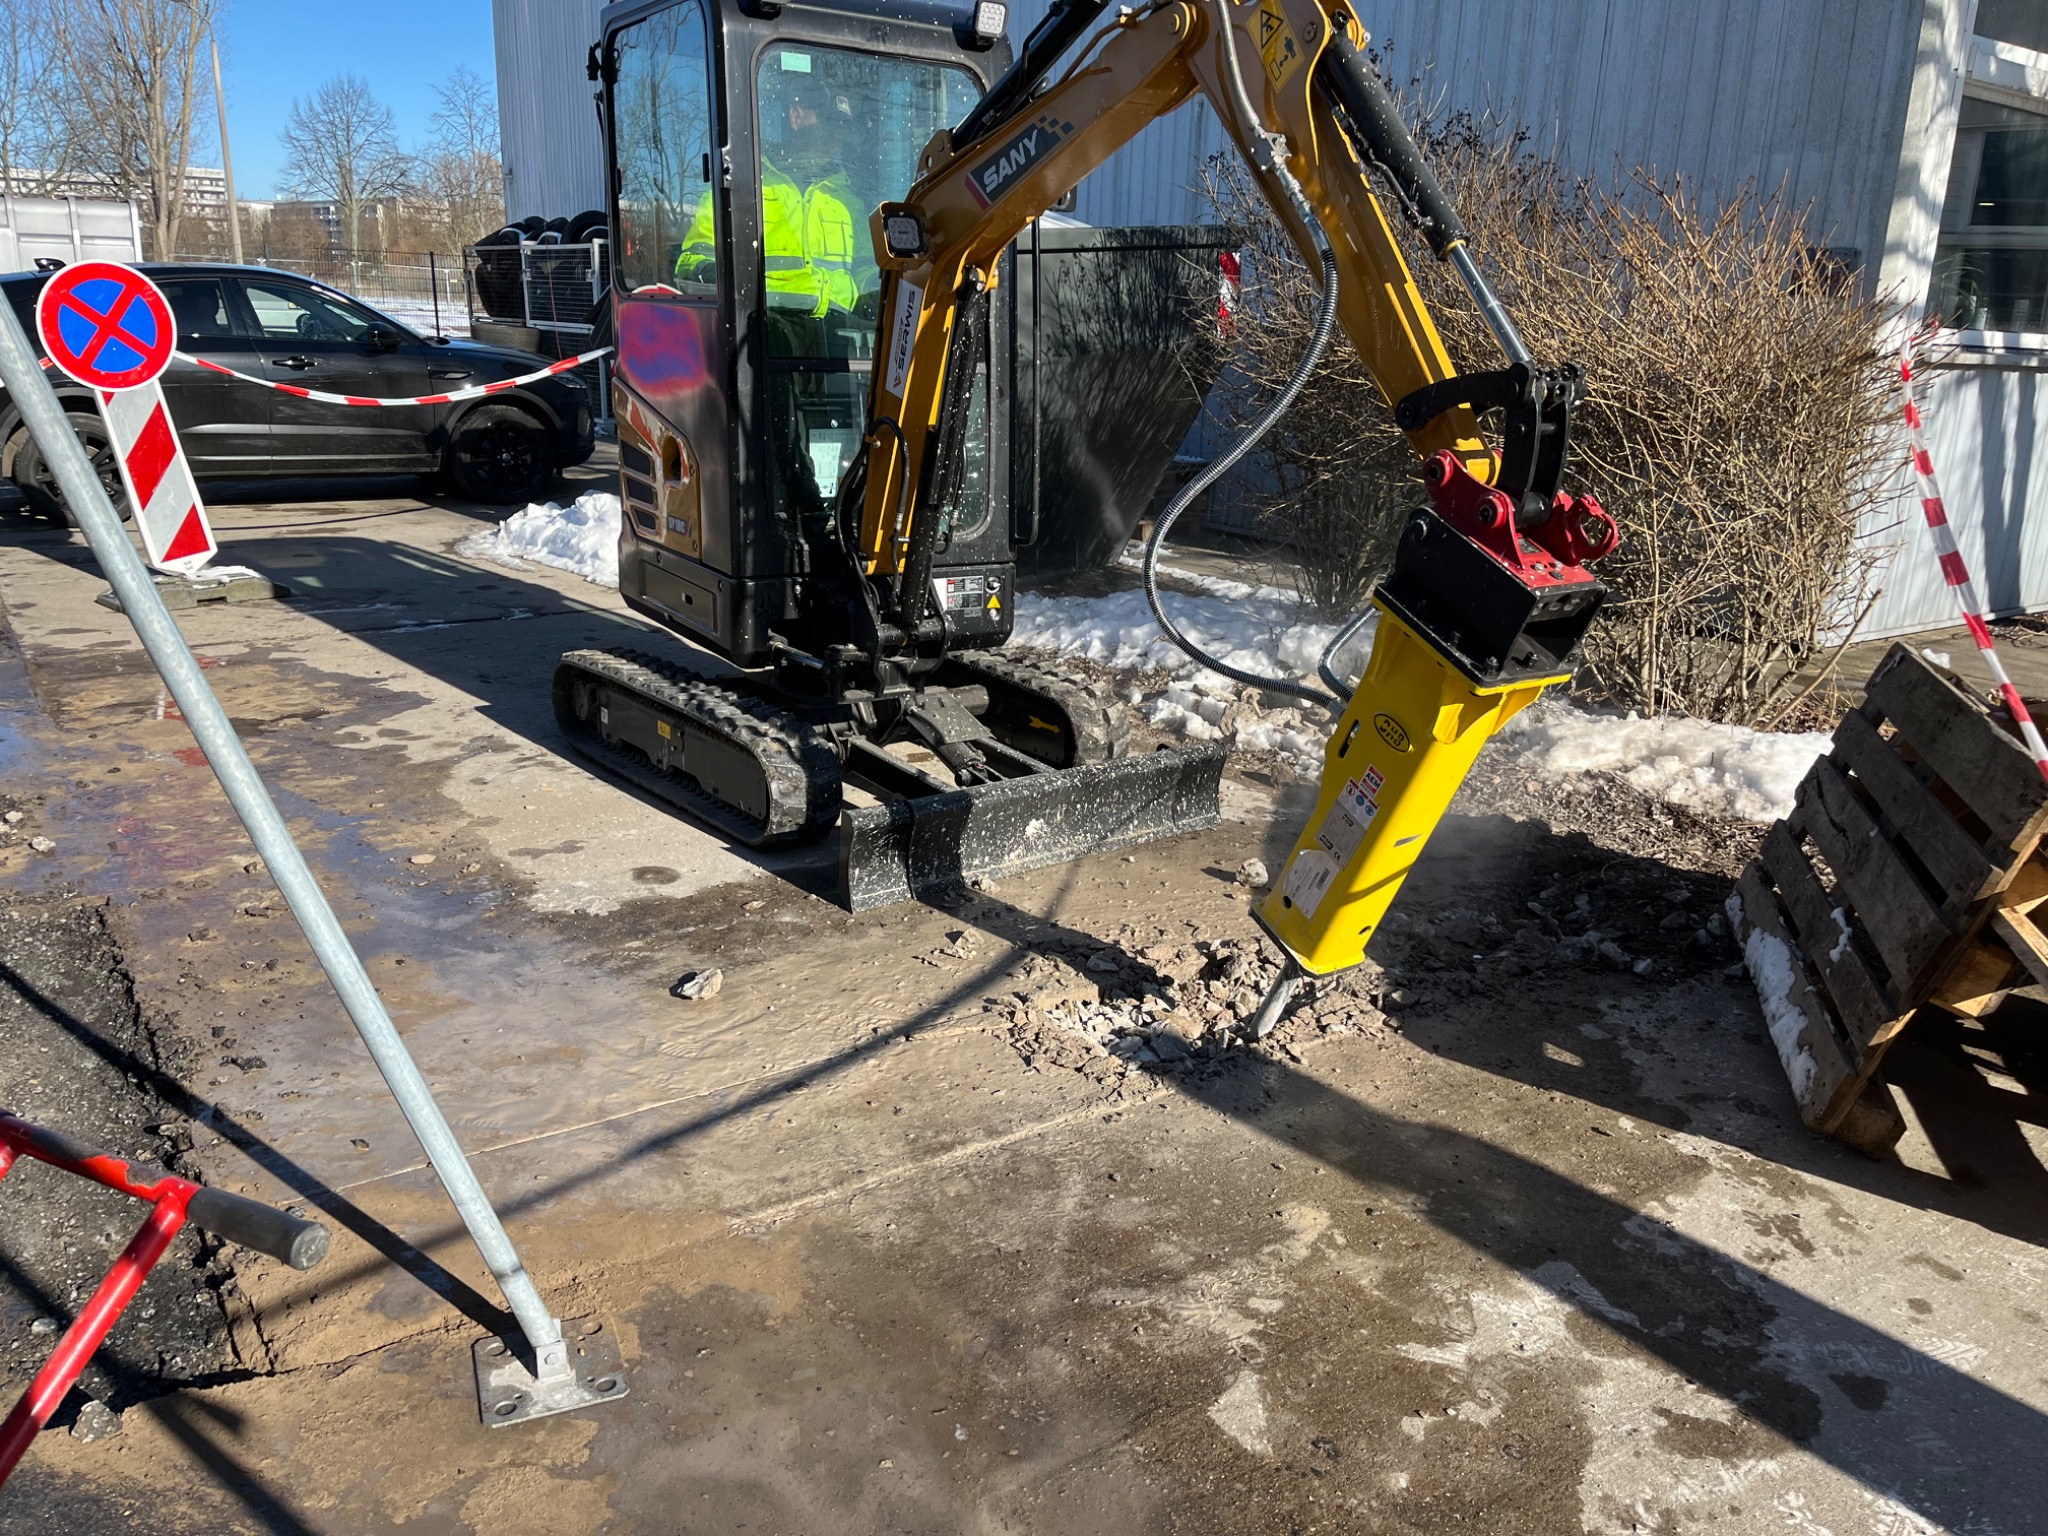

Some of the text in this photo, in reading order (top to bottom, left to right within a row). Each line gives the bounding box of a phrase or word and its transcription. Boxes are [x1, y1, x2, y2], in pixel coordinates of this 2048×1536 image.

[983, 128, 1038, 194] SANY
[898, 289, 916, 371] SERWIS
[1365, 772, 1381, 789] AEM
